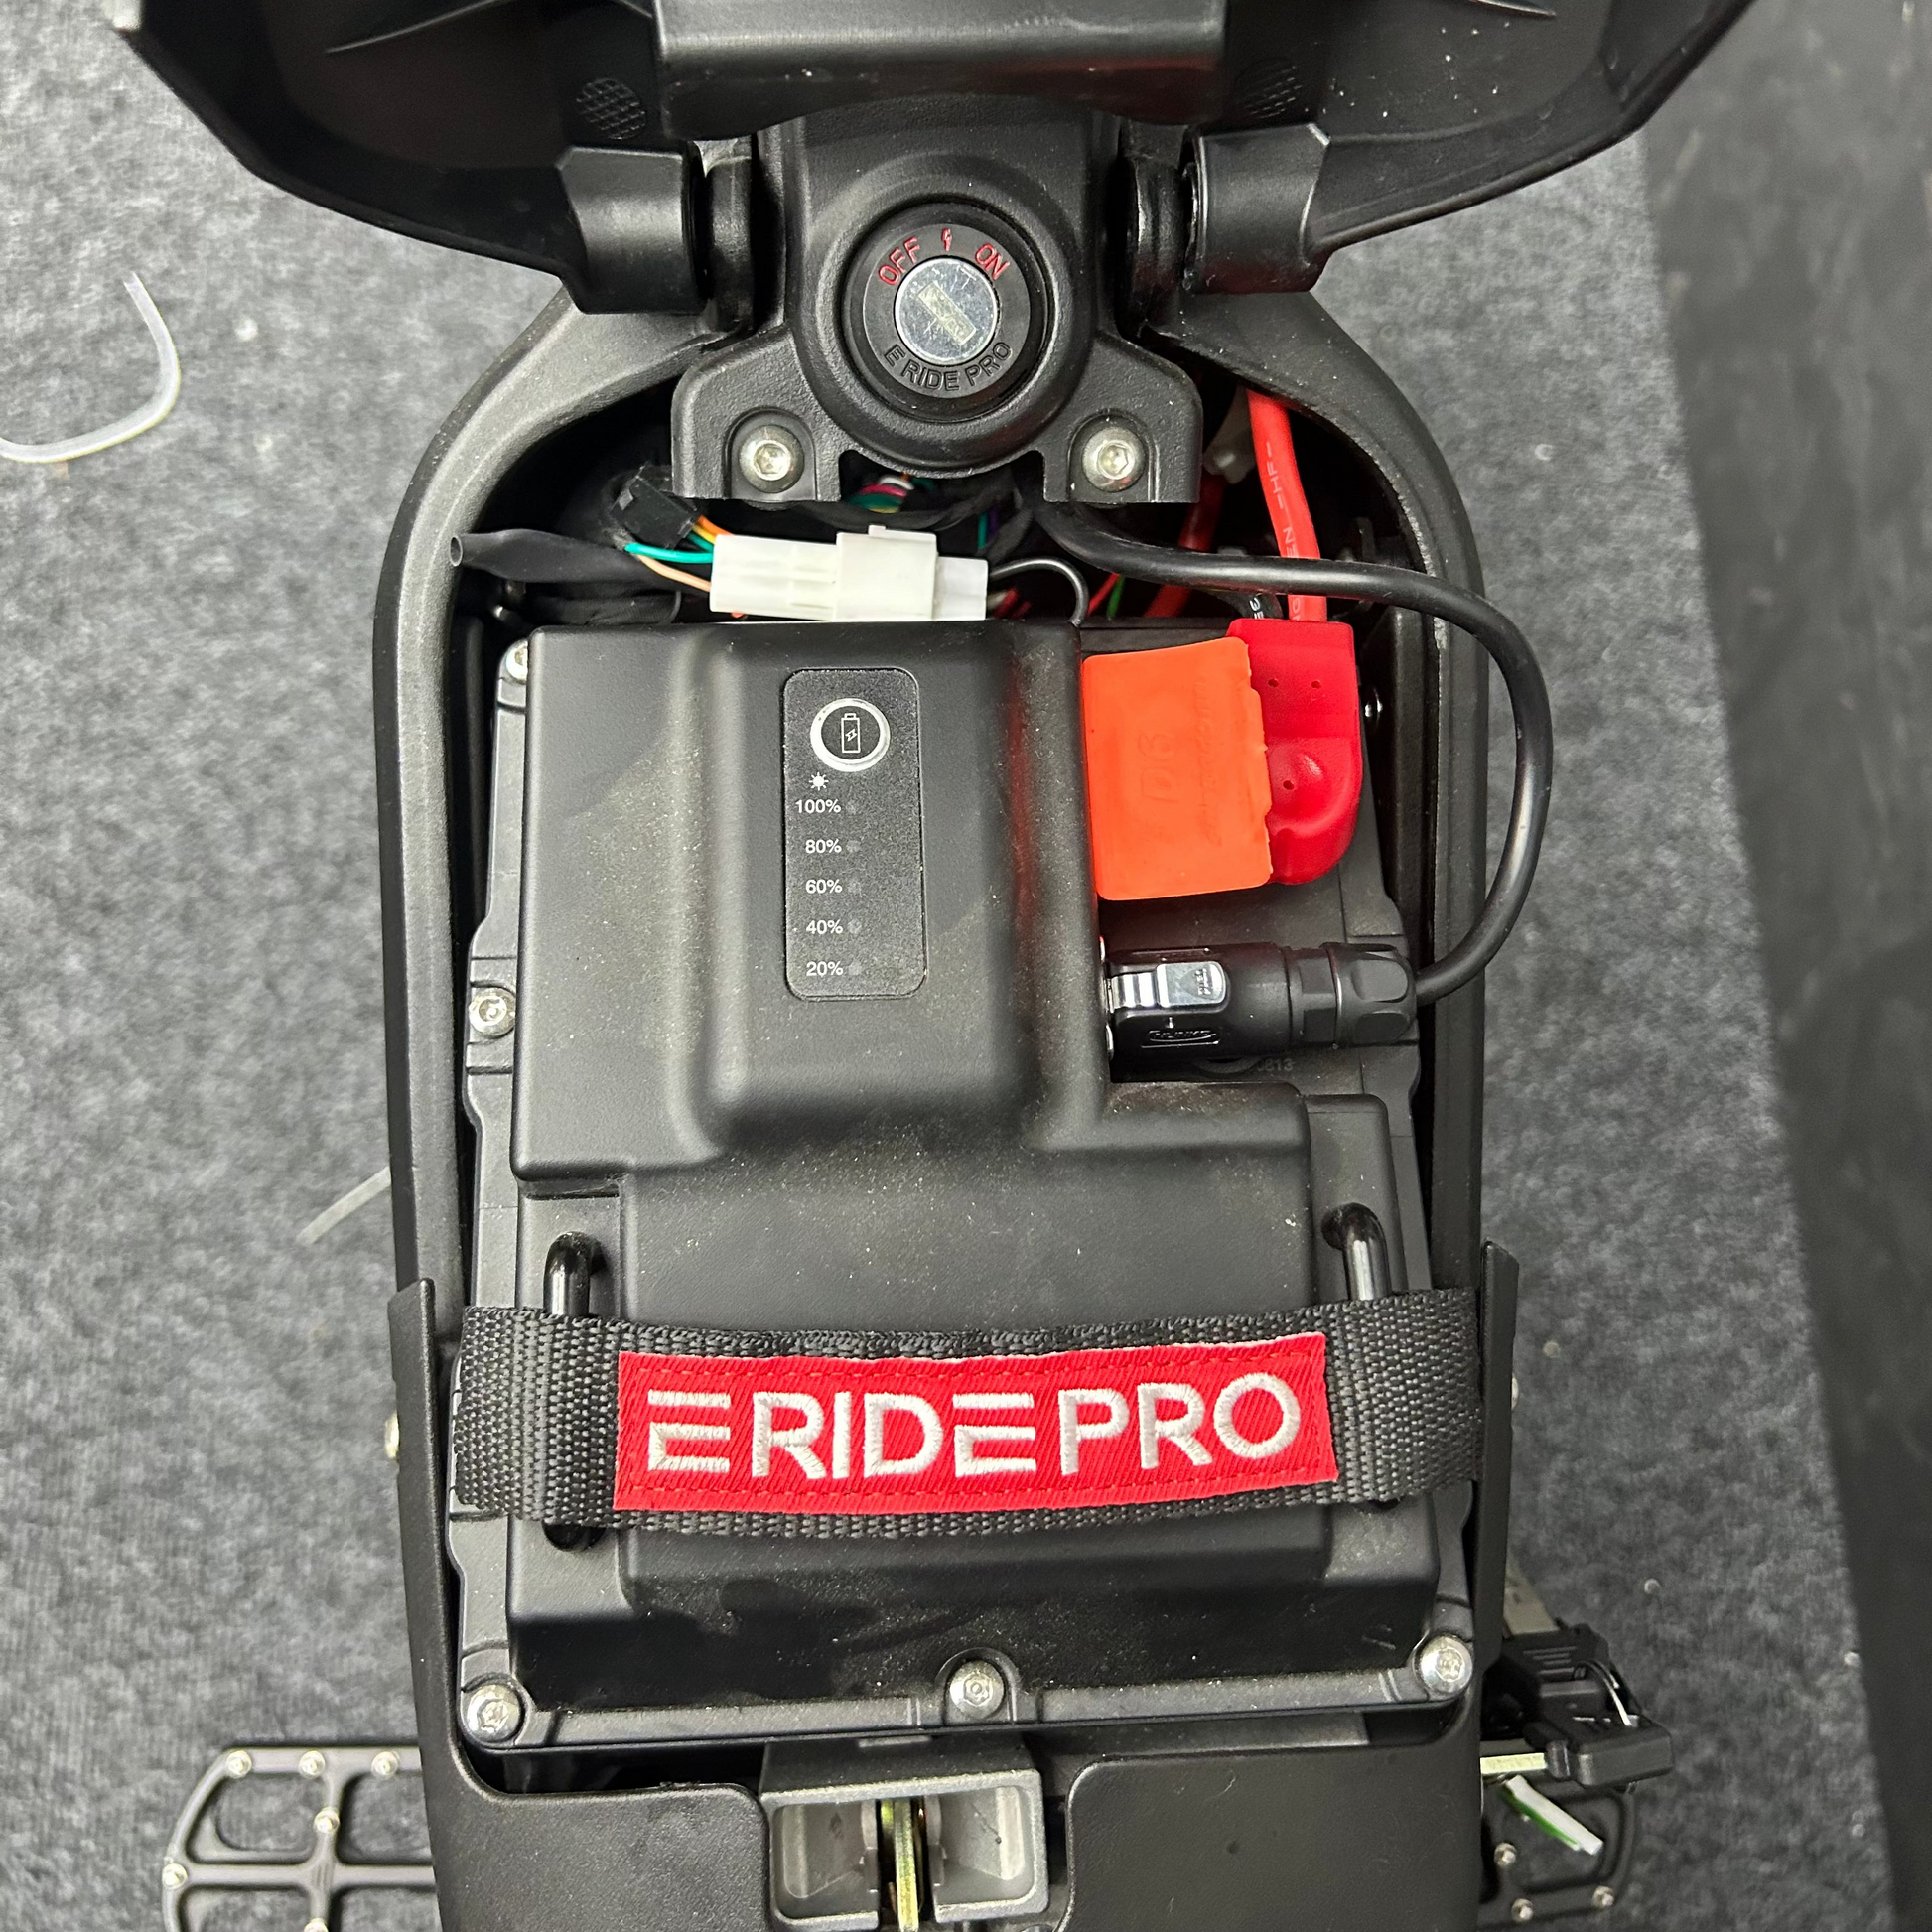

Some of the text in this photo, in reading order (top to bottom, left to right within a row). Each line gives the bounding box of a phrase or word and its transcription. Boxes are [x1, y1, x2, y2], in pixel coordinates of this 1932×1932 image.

[879, 237, 920, 285] OFF
[975, 243, 1010, 280] ON
[965, 342, 1012, 386] PRO
[795, 799, 841, 814] 100%
[805, 839, 842, 853] 80%
[805, 879, 843, 894] 60%
[806, 920, 843, 934] 40%
[806, 962, 844, 977] 20%
[1058, 1372, 1302, 1475] PRO
